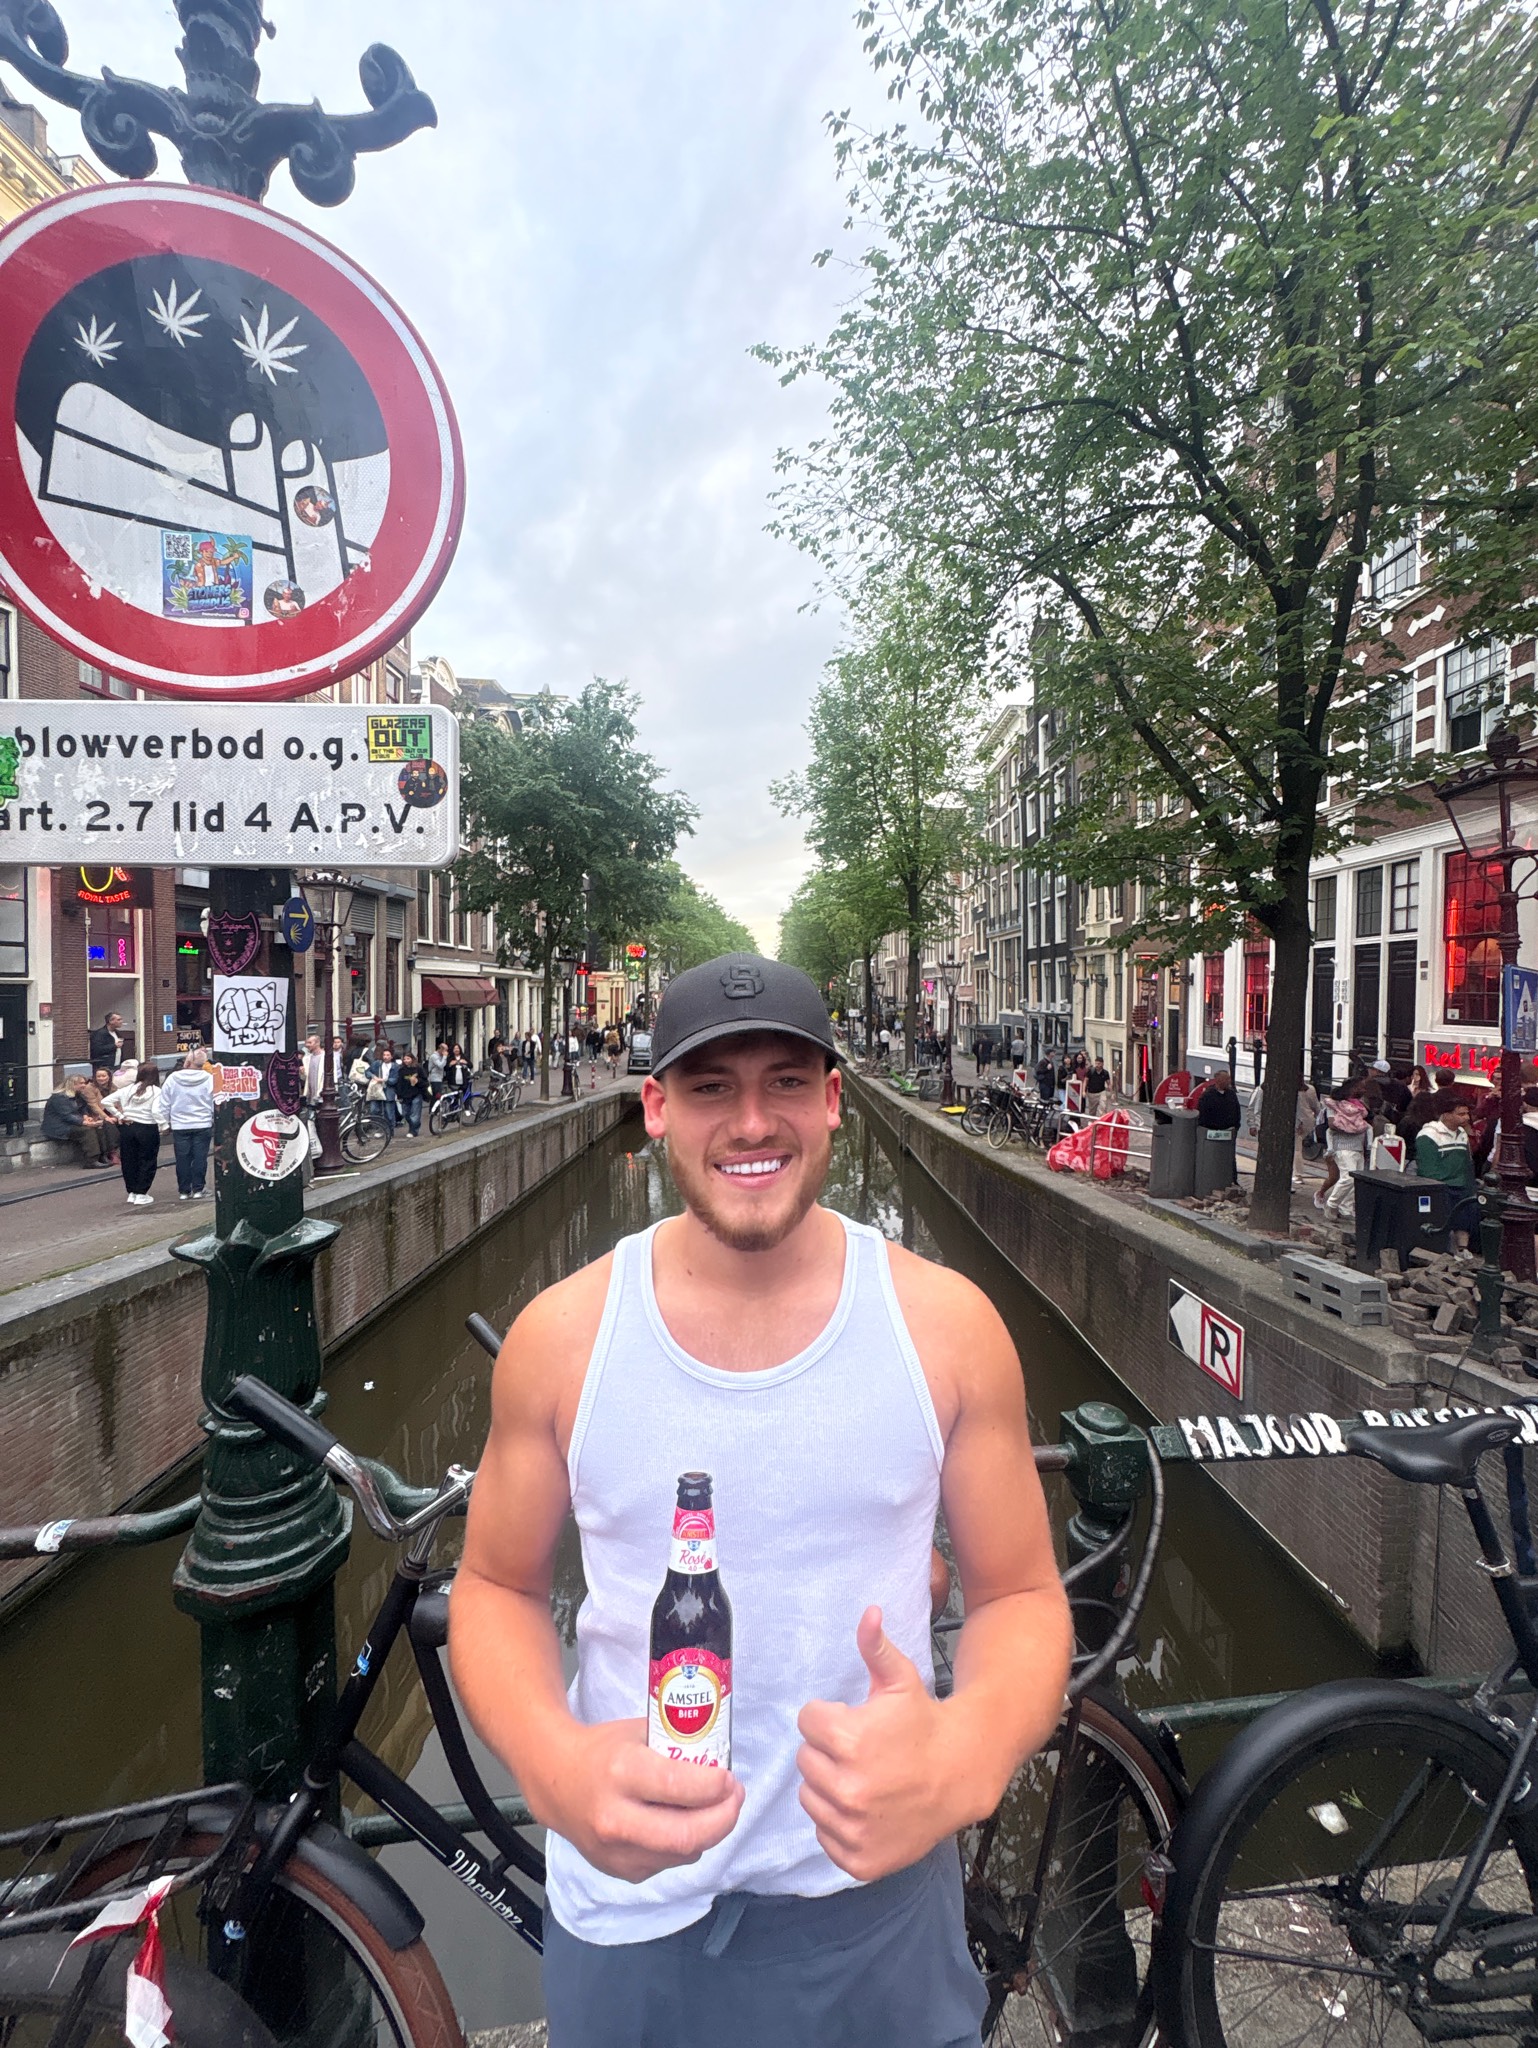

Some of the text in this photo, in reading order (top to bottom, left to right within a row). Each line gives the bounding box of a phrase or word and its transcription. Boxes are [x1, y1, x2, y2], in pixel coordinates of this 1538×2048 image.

[371, 719, 426, 729] GLAZERS
[374, 730, 422, 746] OUT
[14, 726, 369, 771] blowverbod o.g.
[86, 801, 153, 832] 2.7
[173, 802, 224, 832] lid
[244, 802, 272, 832] 4
[290, 802, 426, 833] A.P.V.
[77, 890, 131, 903] ROYAL TASTE
[117, 938, 127, 966] open
[228, 1027, 276, 1047] TDM
[176, 1043, 189, 1052] FOR
[1424, 1043, 1463, 1070] Red
[1468, 1046, 1503, 1081] Lig
[1210, 1321, 1231, 1368] P
[681, 1530, 708, 1538] AMSTEL
[679, 1549, 707, 1565] Rosé
[667, 1691, 712, 1705] AMSTEL
[678, 1709, 699, 1719] BIER
